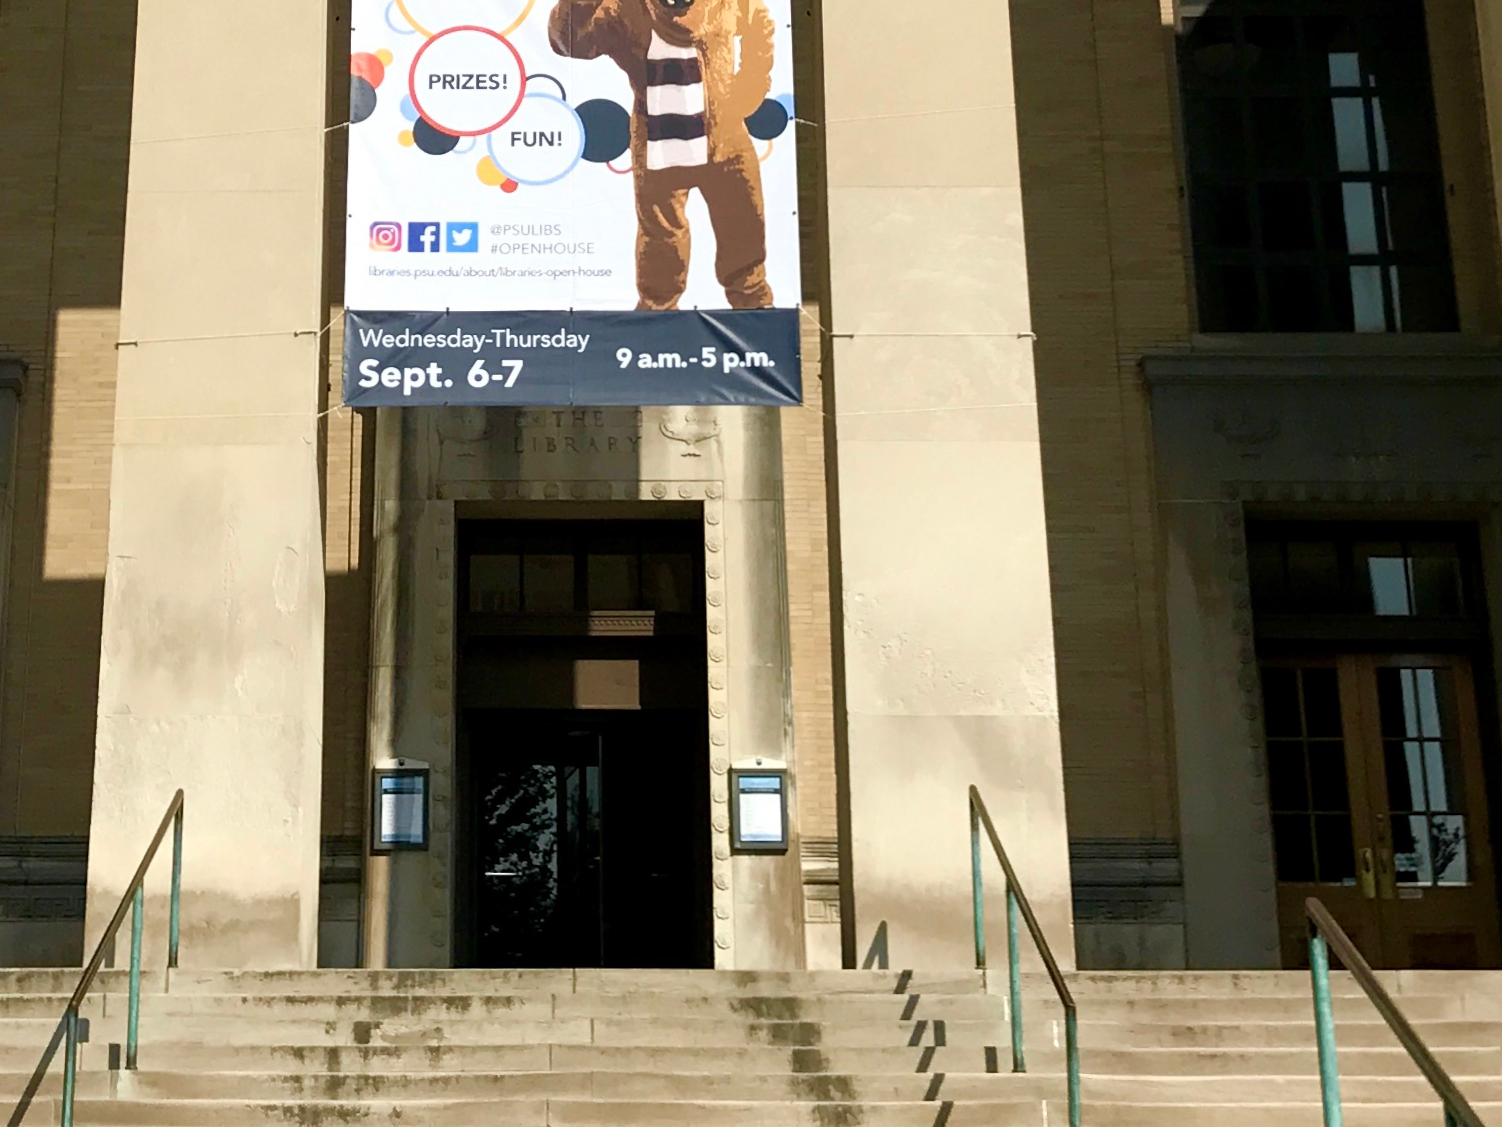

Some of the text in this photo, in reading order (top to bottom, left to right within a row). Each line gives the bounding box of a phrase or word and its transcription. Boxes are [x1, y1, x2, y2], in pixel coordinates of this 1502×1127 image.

[428, 73, 507, 90] PRIZES!
[510, 131, 562, 147] FUN!
[490, 224, 562, 236] @PSULIBS
[490, 242, 595, 255] #OPENHOUSE
[368, 265, 613, 280] libraries.psu.edu/about/libraries-open-house
[358, 327, 590, 353] Wednesday-Thursday
[615, 347, 633, 369] 9
[722, 350, 776, 374] p.m.
[358, 358, 524, 396] Sept. 6-7
[551, 410, 605, 428] THE
[513, 436, 643, 454] LIBRARY
